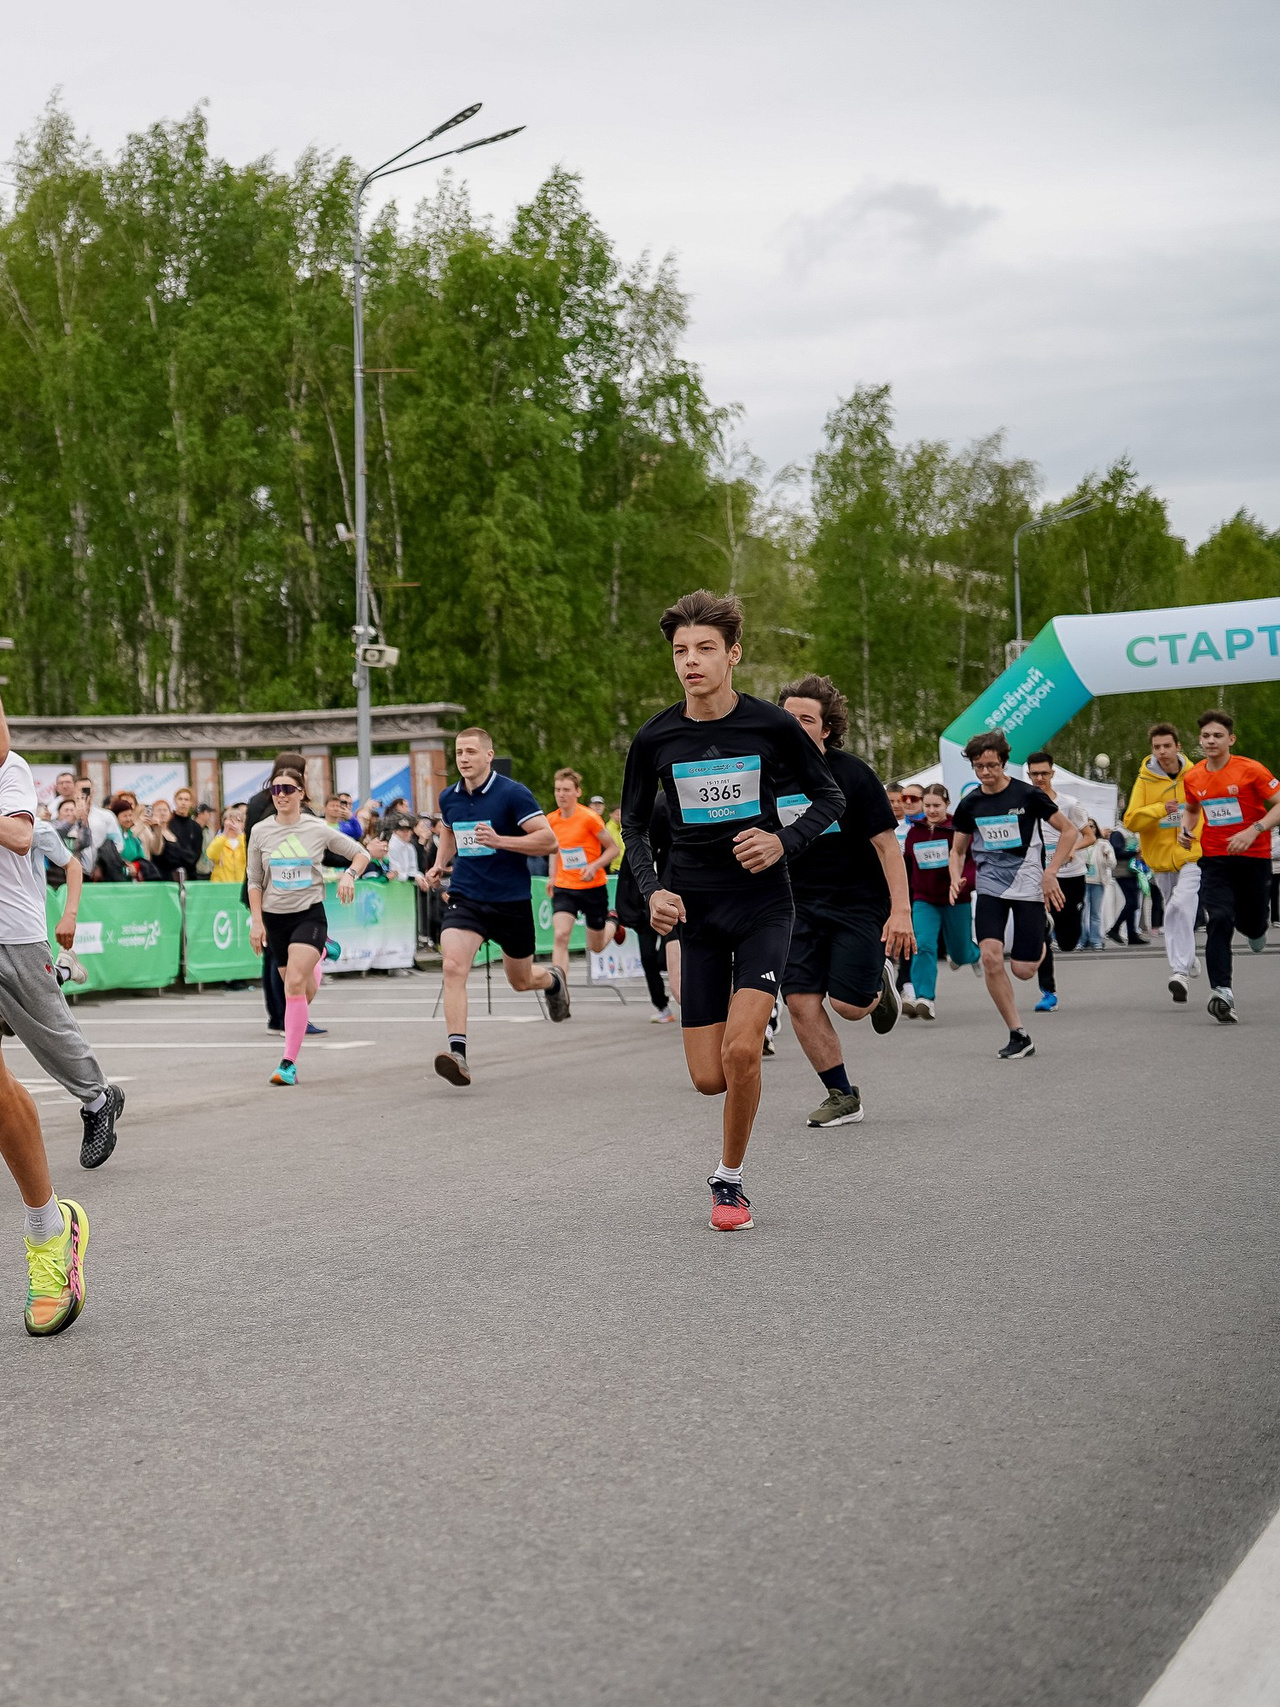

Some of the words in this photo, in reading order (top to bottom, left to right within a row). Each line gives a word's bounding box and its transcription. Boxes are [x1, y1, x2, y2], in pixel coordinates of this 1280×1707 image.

[1126, 624, 1280, 668] СТАРТ
[984, 666, 1044, 729] зелёный
[699, 784, 741, 802] 3365
[987, 829, 1009, 839] 3310
